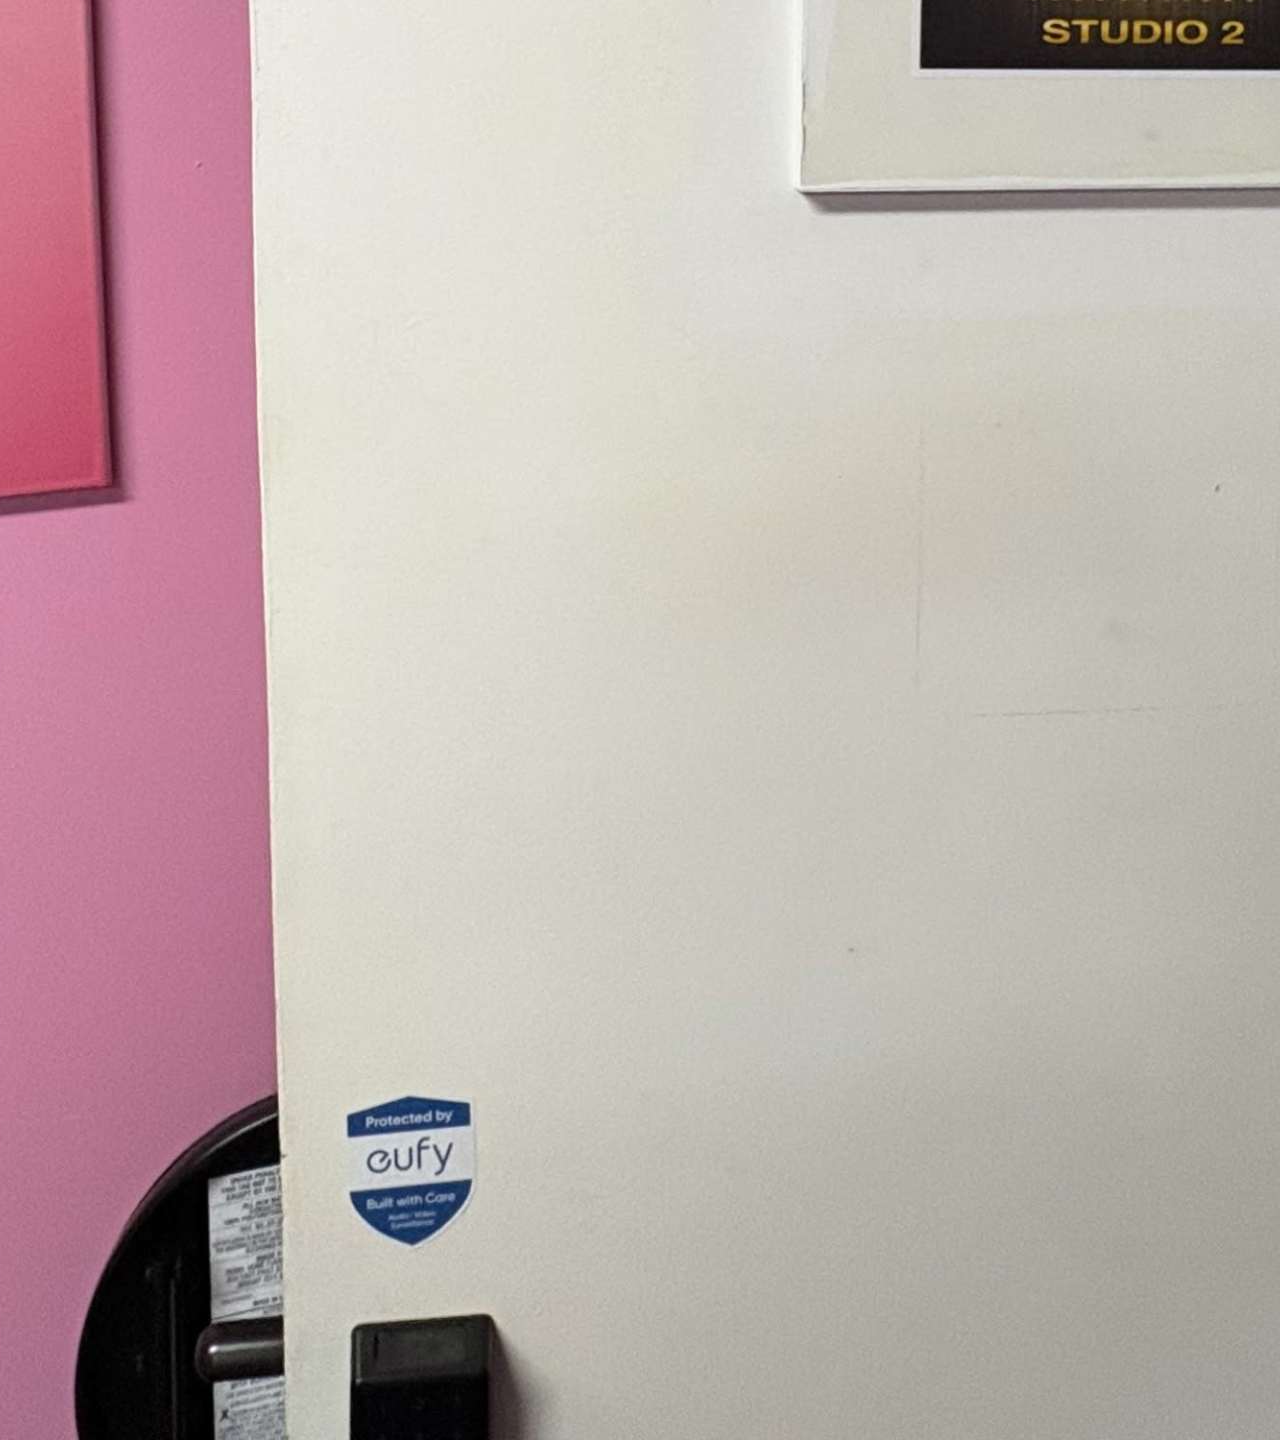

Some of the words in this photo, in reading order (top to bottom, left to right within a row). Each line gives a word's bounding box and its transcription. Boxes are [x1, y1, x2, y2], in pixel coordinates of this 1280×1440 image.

[1041, 19, 1211, 44] STUDIO
[1221, 20, 1245, 44] 2
[365, 1110, 432, 1128] Protected
[435, 1110, 453, 1124] by
[366, 1136, 454, 1176] eufy
[366, 1196, 394, 1210] Built
[396, 1195, 423, 1207] with
[425, 1191, 456, 1203] Care
